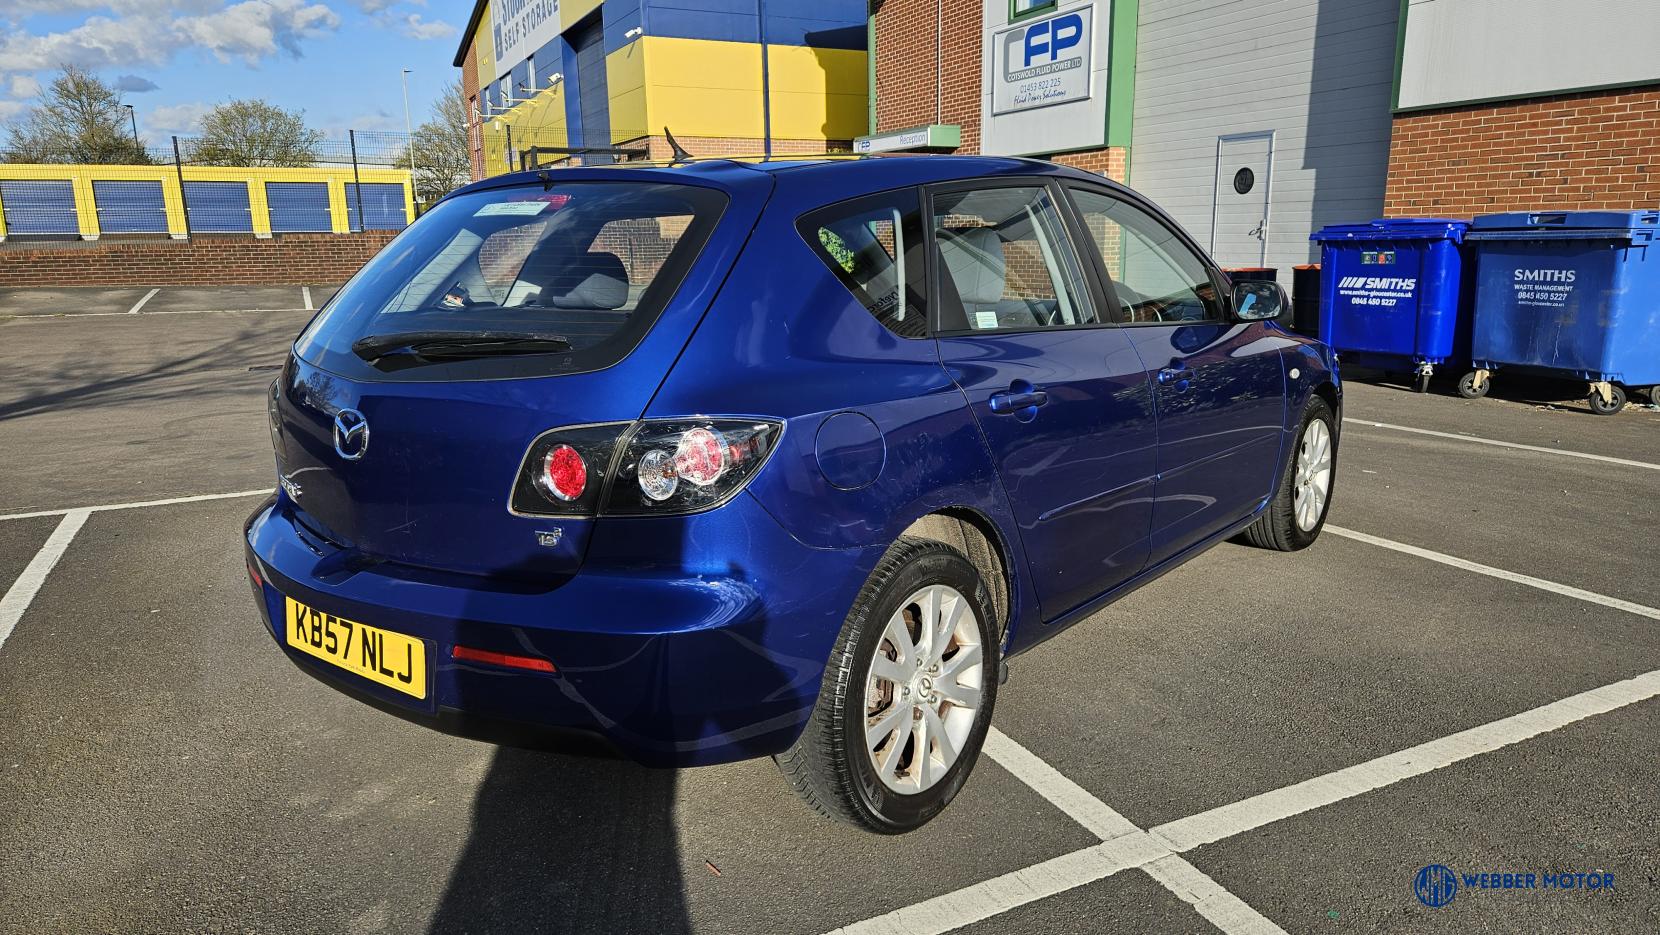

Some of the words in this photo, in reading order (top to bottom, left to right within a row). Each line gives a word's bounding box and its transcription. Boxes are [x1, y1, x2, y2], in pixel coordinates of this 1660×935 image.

[505, 22, 519, 52] SELF
[522, 0, 558, 38] STORAGE
[1007, 69, 1036, 82] COTSWOLD
[1036, 66, 1051, 76] FLUID
[1052, 61, 1071, 72] POWER
[1071, 58, 1081, 68] LTD
[1020, 82, 1037, 94] 01453
[1050, 77, 1061, 88] 225
[1014, 93, 1027, 105] Fluid
[1043, 89, 1066, 100] Solutions
[900, 133, 926, 146] Reception
[1514, 268, 1576, 283] SMITHS
[1365, 278, 1416, 290] SMITHS
[1534, 284, 1573, 292] MANAGEMENT
[1351, 297, 1367, 305] 0845
[1367, 298, 1380, 306] 450
[1381, 298, 1397, 307] 5227
[1518, 292, 1534, 300] 0845
[1536, 292, 1548, 300] 450
[1549, 293, 1567, 301] 5227
[295, 602, 354, 660] KB57
[361, 627, 413, 685] NLJ
